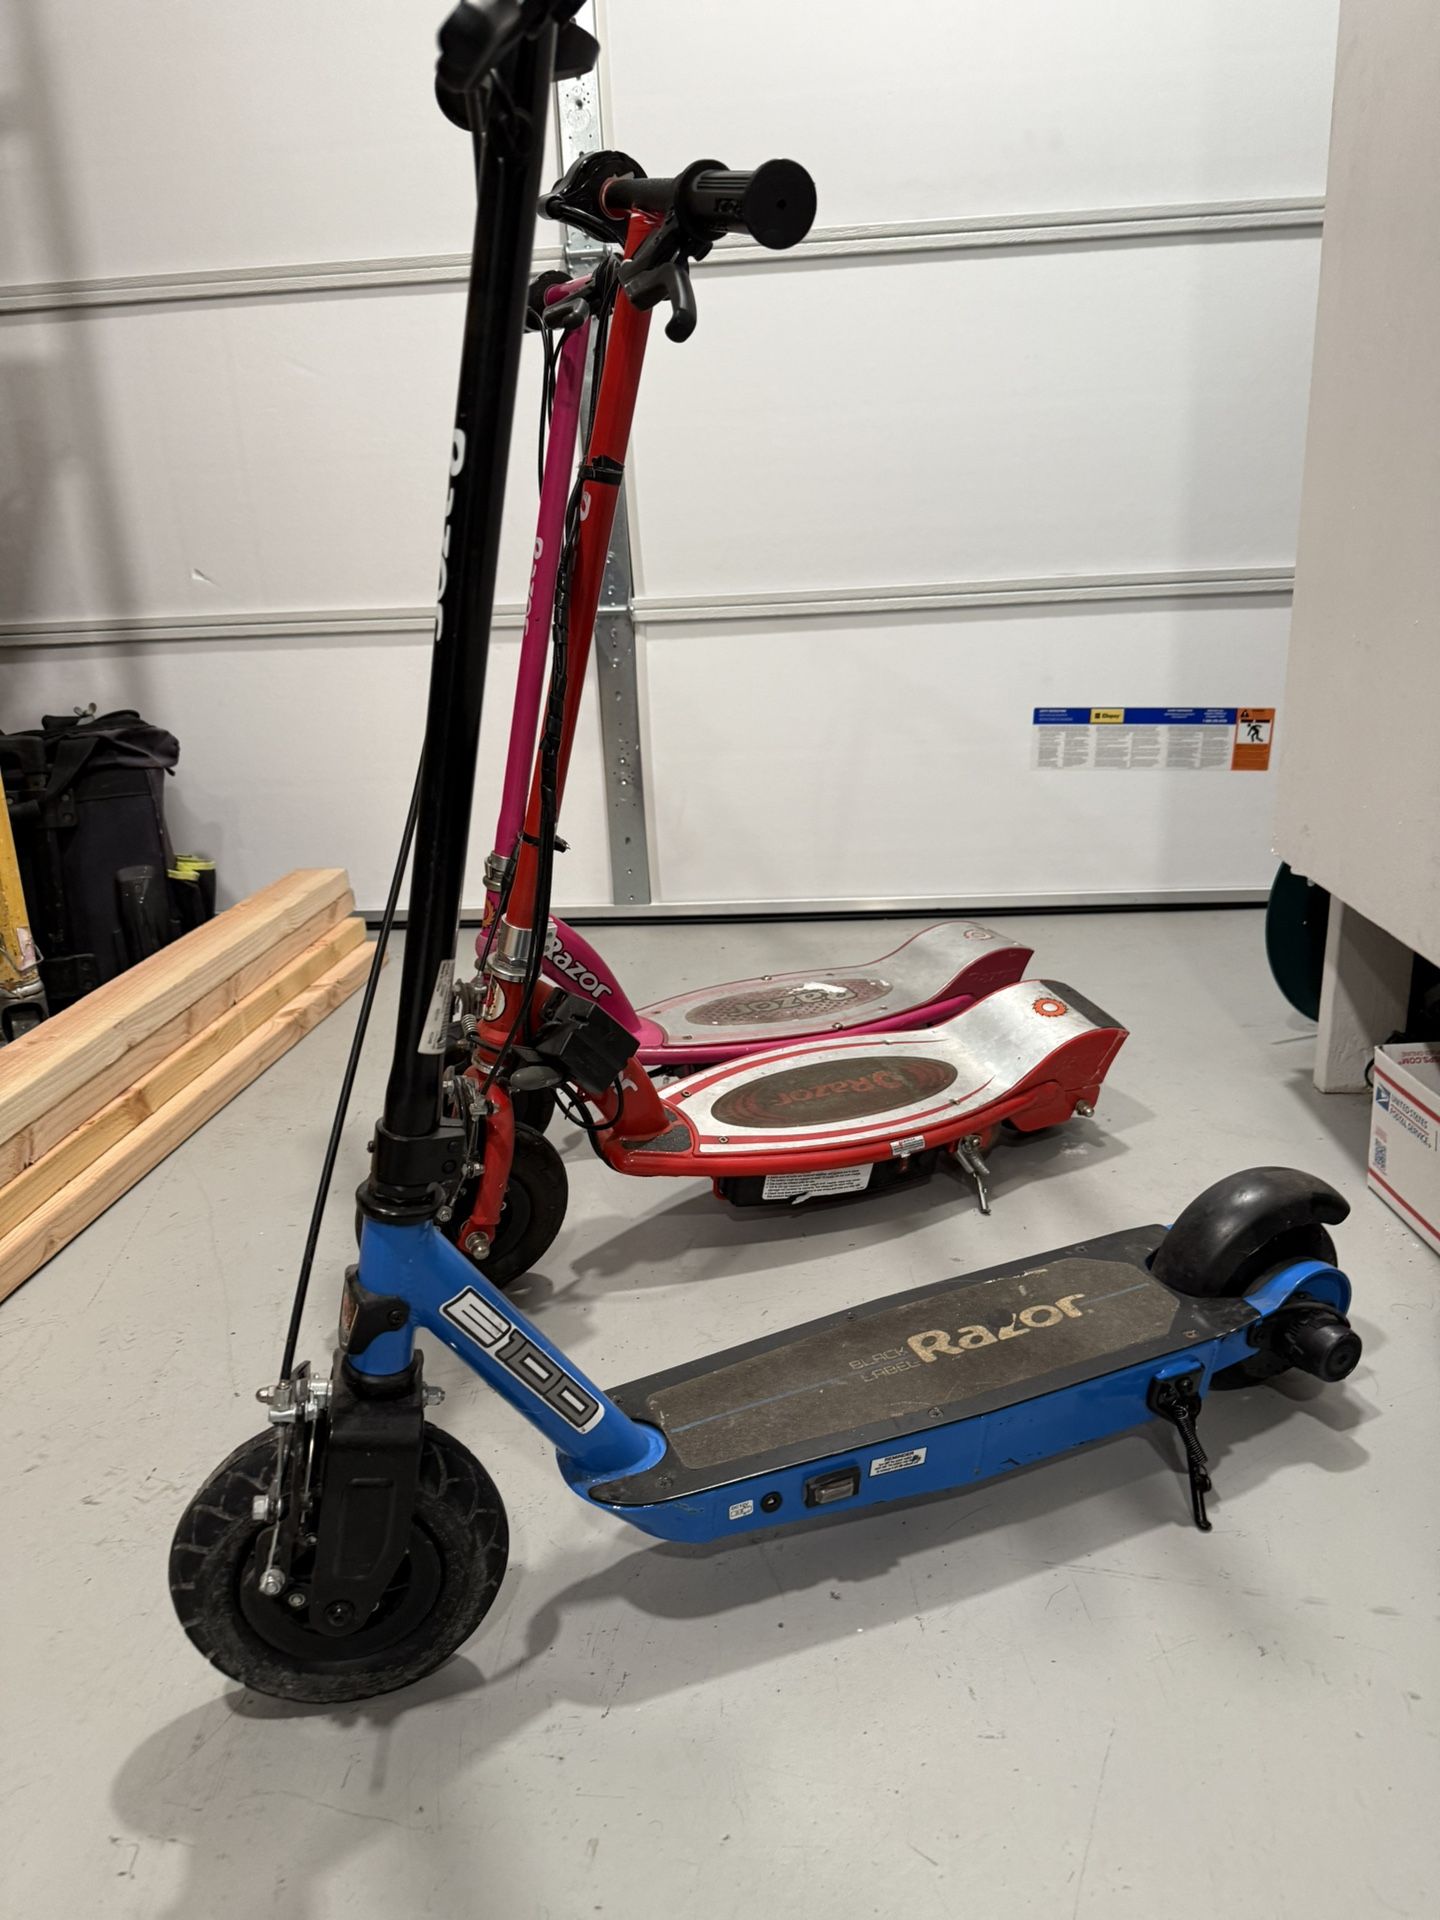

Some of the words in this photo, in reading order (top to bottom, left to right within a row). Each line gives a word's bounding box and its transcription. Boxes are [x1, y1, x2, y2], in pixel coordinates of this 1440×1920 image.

[441, 1285, 603, 1432] E100
[849, 1347, 907, 1370] BLACK
[861, 1360, 922, 1383] LABEL
